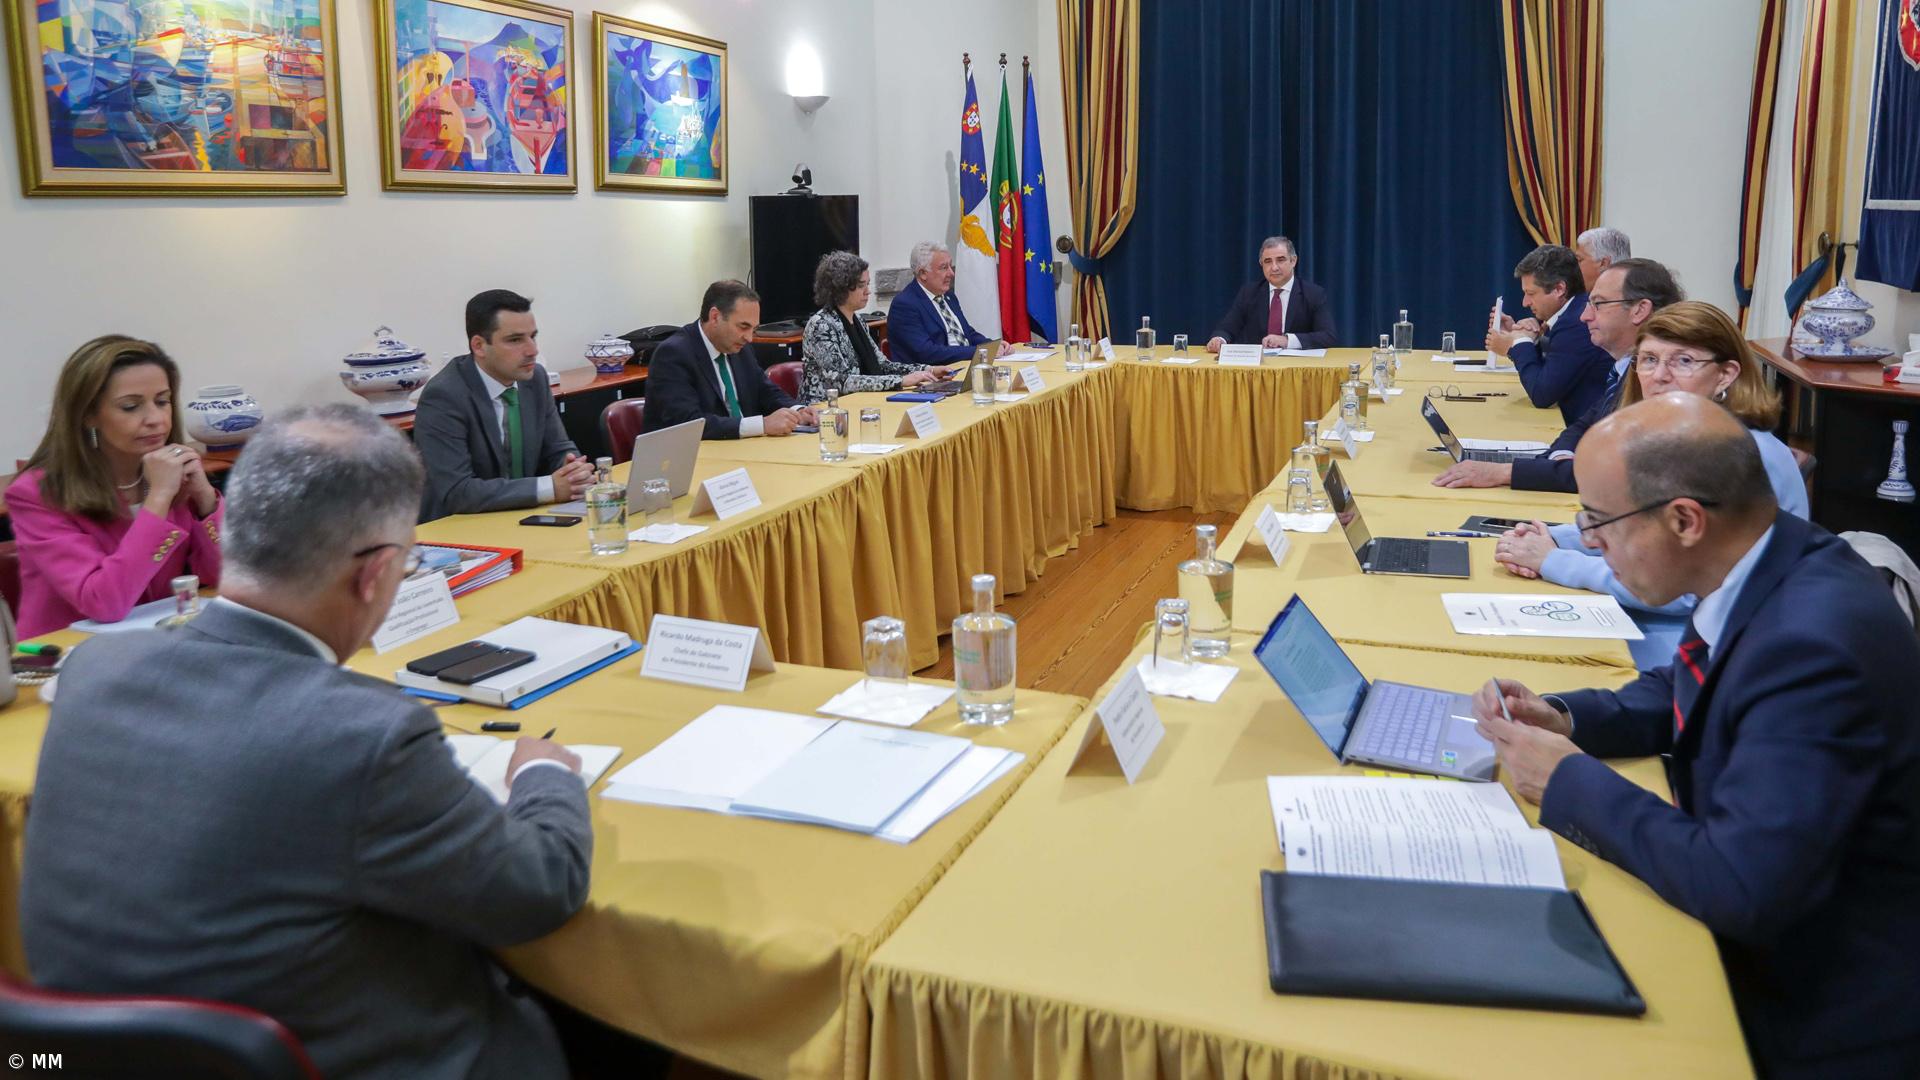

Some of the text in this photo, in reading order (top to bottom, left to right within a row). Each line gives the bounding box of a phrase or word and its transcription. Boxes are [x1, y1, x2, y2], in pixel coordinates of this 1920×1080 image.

[659, 630, 685, 641] Ricardo
[685, 633, 714, 646] Madruga
[724, 639, 743, 649] Costa
